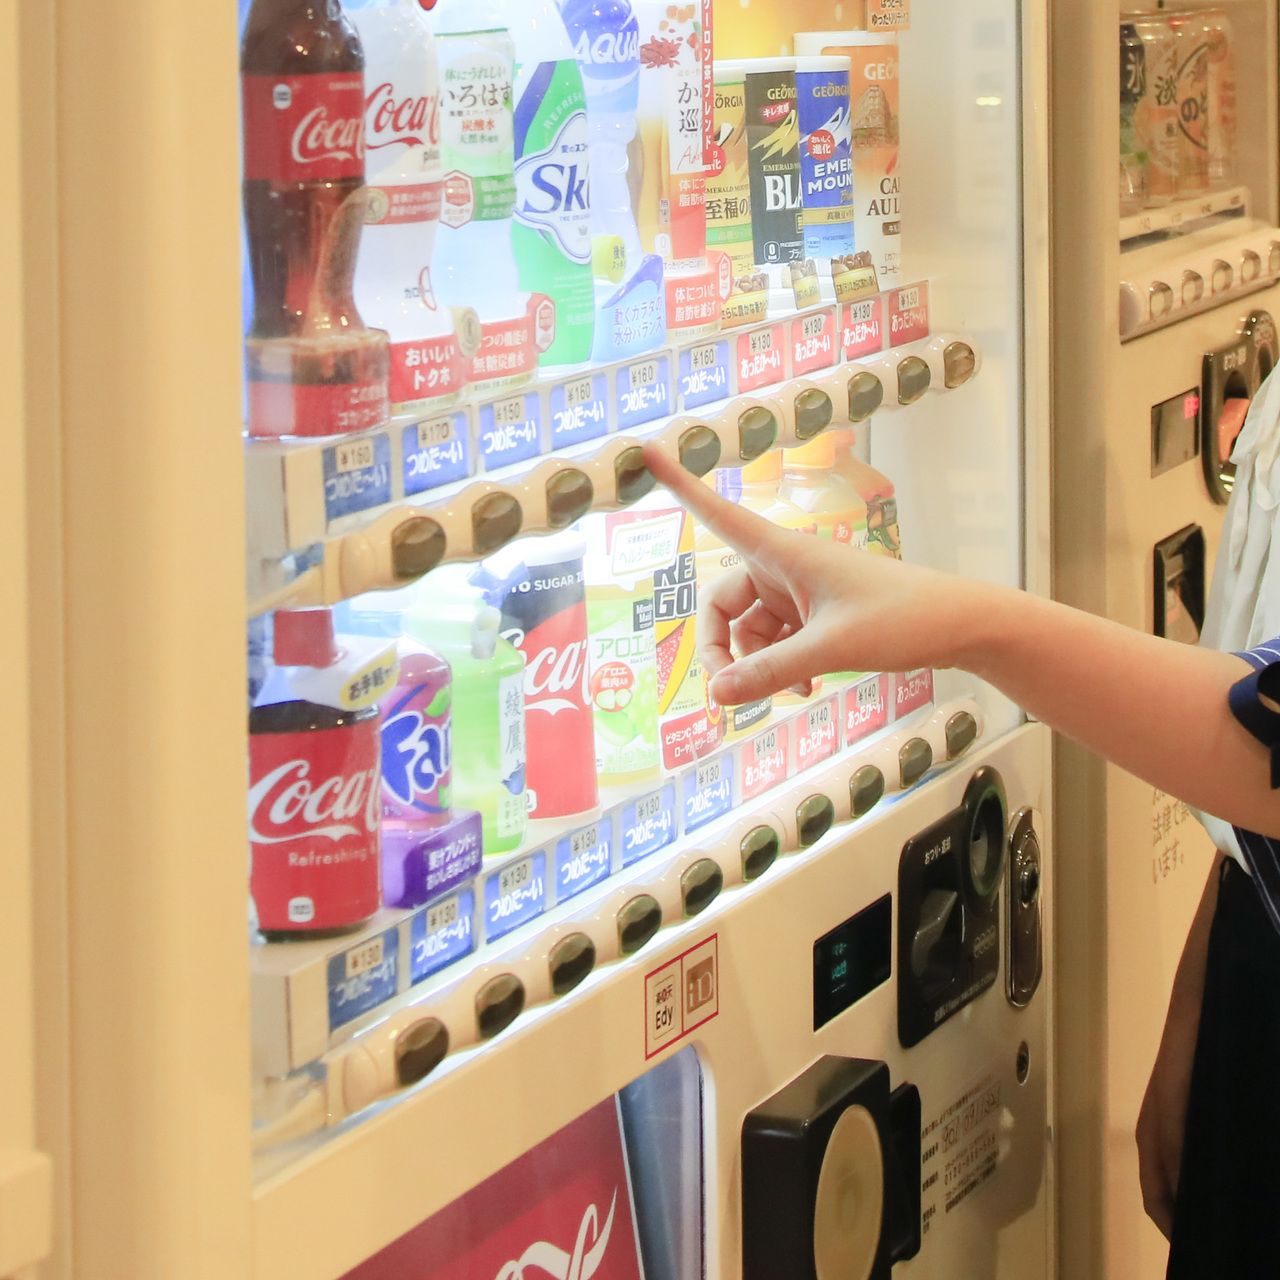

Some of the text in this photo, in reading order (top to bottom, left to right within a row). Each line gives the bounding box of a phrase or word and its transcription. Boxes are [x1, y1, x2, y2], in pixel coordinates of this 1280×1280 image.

[440, 81, 511, 108] いろはす
[714, 93, 744, 110] ORGIA
[614, 296, 662, 325] 動くカラダの
[852, 303, 871, 319] ¥130
[614, 317, 662, 346] 水分バランス
[804, 318, 823, 335] ¥130
[406, 343, 455, 363] おいしい
[751, 334, 771, 351] ¥130
[693, 349, 714, 366] ¥160
[414, 370, 450, 391] トクホ
[631, 365, 654, 382] ¥160
[568, 386, 591, 402] ¥160
[534, 576, 575, 592] SUGAR
[654, 585, 697, 621] GO
[756, 731, 776, 752] ¥140
[699, 763, 720, 785] ¥130
[637, 795, 660, 819] ¥130
[573, 828, 597, 854] ¥130
[288, 849, 368, 867] Refreshing
[686, 967, 715, 1011] iD
[655, 1005, 674, 1030] Edy
